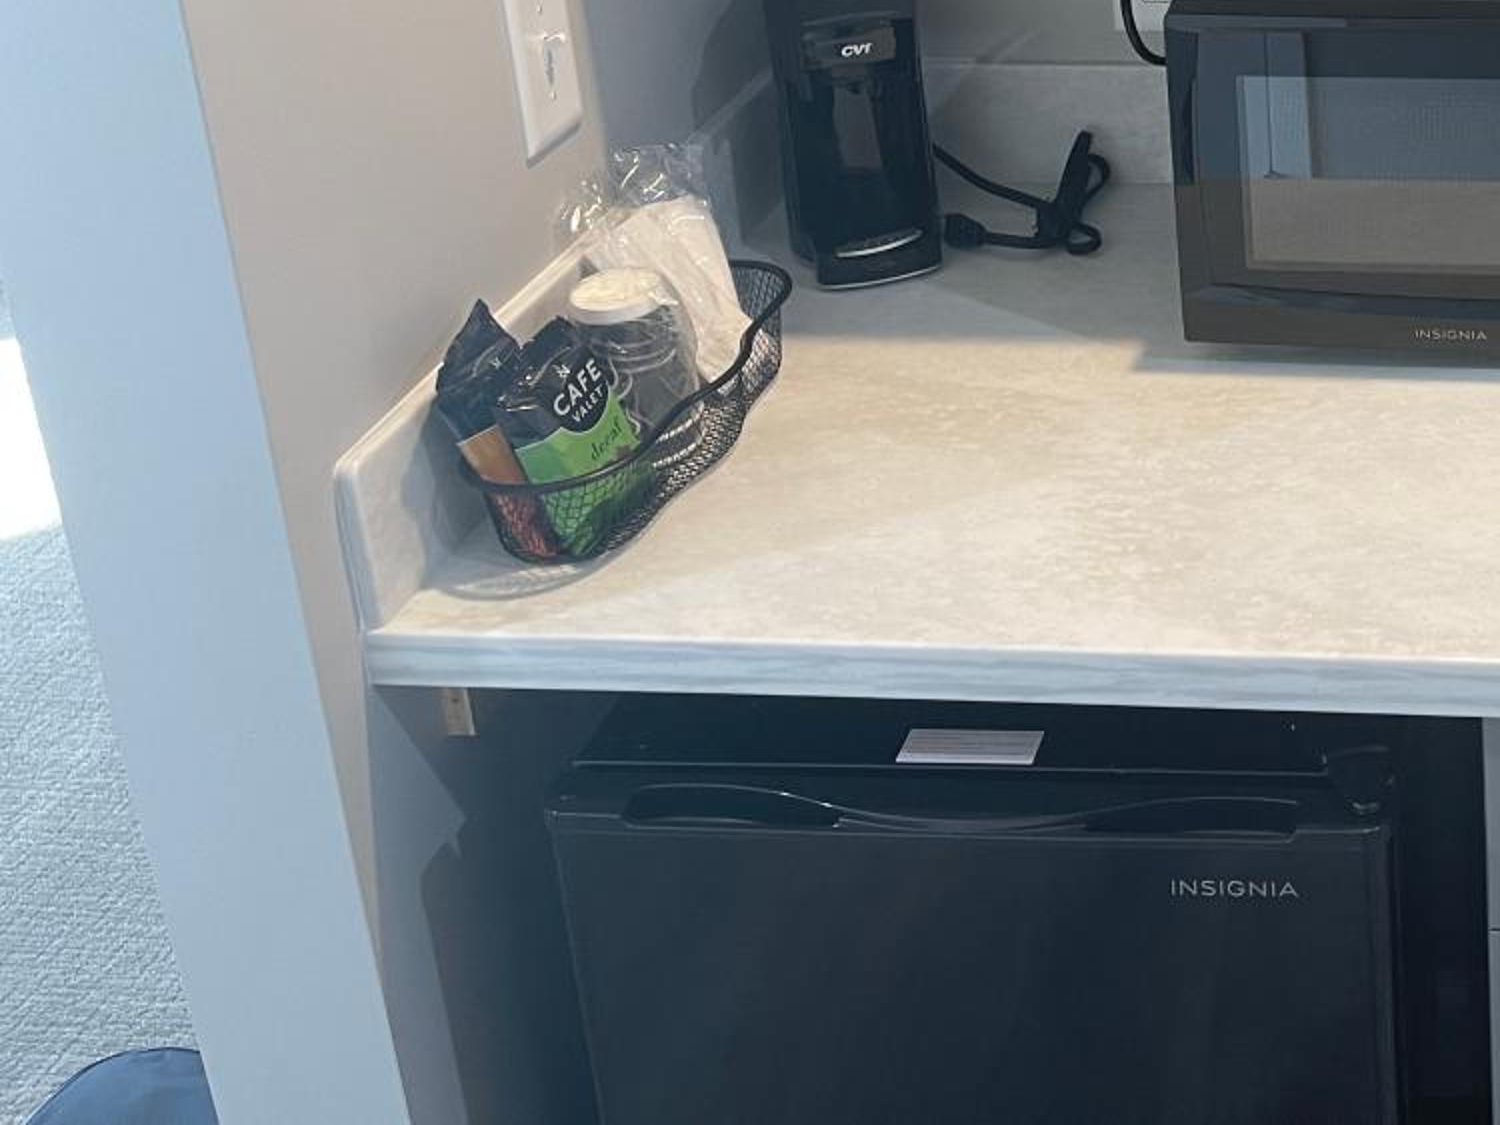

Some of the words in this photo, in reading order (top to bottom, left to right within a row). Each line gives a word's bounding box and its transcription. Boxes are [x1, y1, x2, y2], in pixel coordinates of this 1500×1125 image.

[1415, 330, 1487, 340] INSIGNIA
[553, 358, 603, 415] CAFE
[571, 383, 603, 422] VALET
[1170, 878, 1299, 898] INSIGNIA
